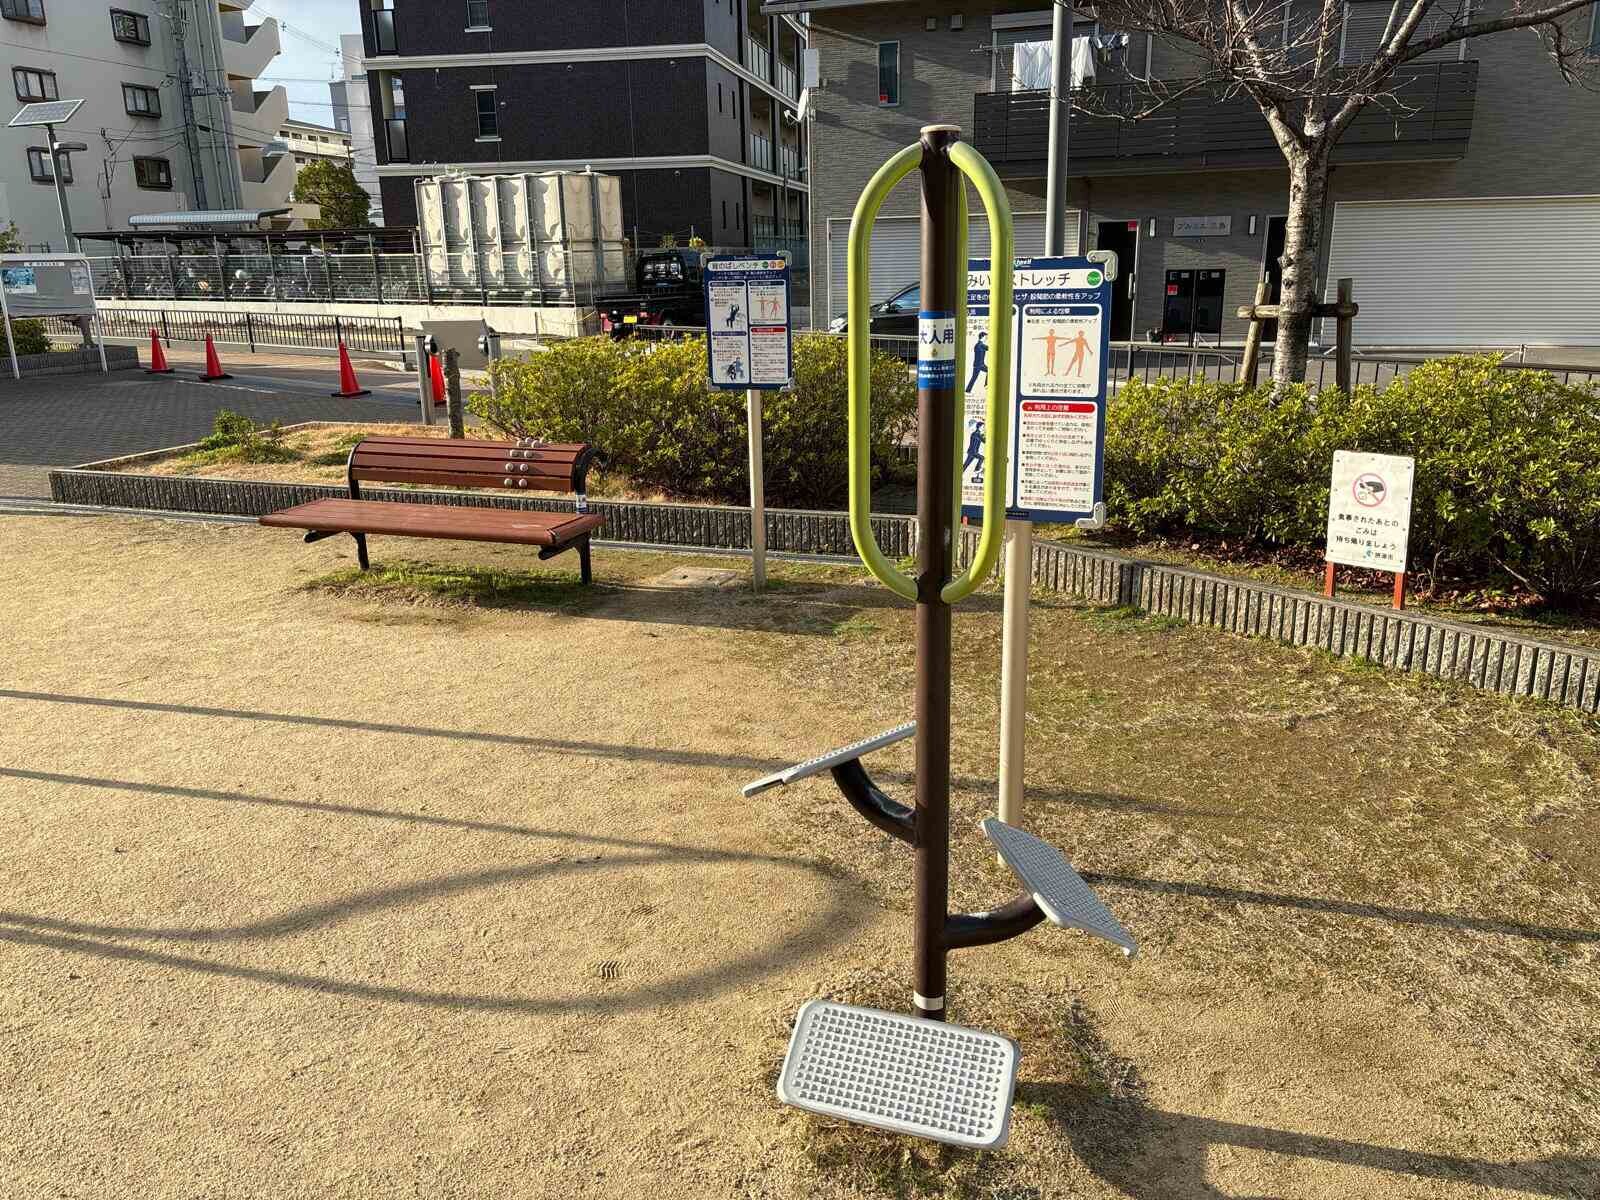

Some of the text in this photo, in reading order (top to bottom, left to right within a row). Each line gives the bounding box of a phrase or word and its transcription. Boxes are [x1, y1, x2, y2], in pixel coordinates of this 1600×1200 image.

[919, 328, 954, 345] 大人用
[1338, 513, 1399, 527] 食事されたあとの
[1355, 527, 1378, 536] ごみは
[1335, 535, 1397, 550] 持ち帰りましょう
